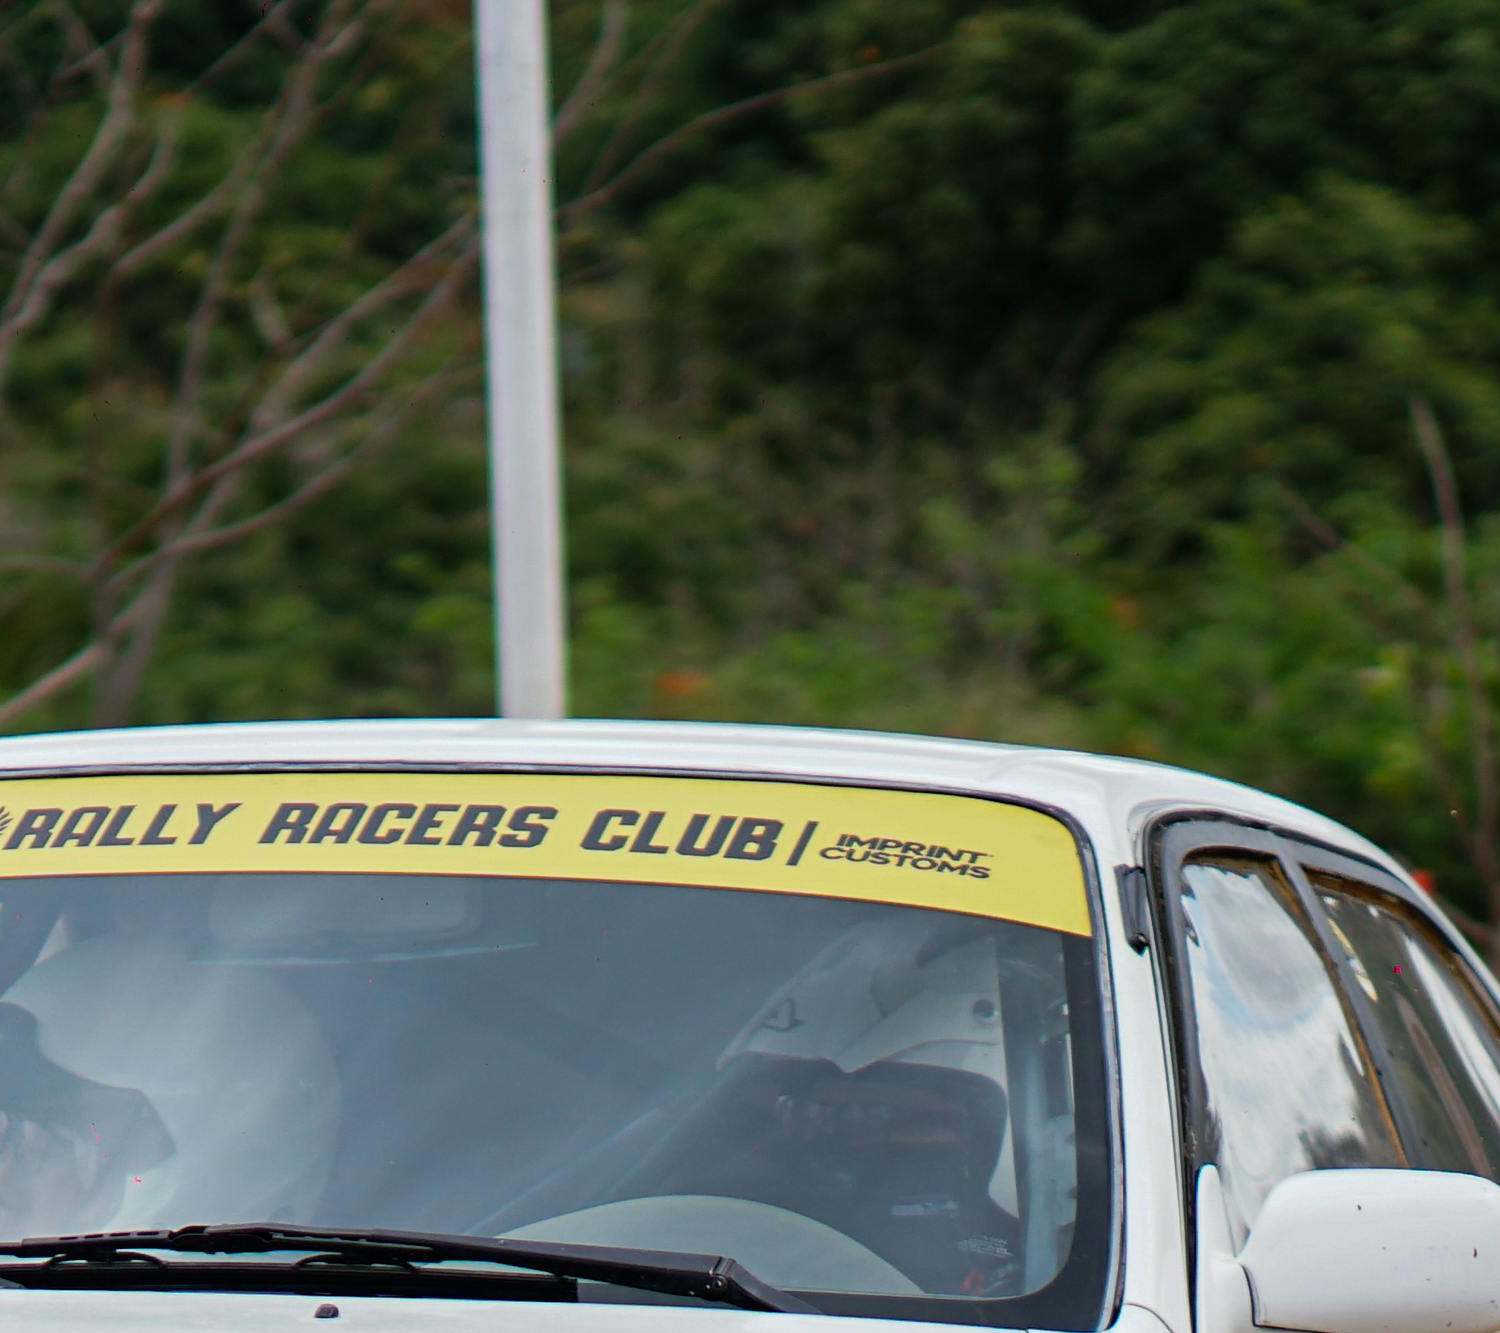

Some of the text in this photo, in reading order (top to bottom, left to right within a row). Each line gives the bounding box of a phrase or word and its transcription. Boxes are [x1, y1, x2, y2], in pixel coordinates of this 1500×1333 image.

[2, 802, 785, 861] RALLY RACERS CLUB
[819, 846, 992, 878] CUSTOMS
[835, 833, 991, 865] IMPRINT
